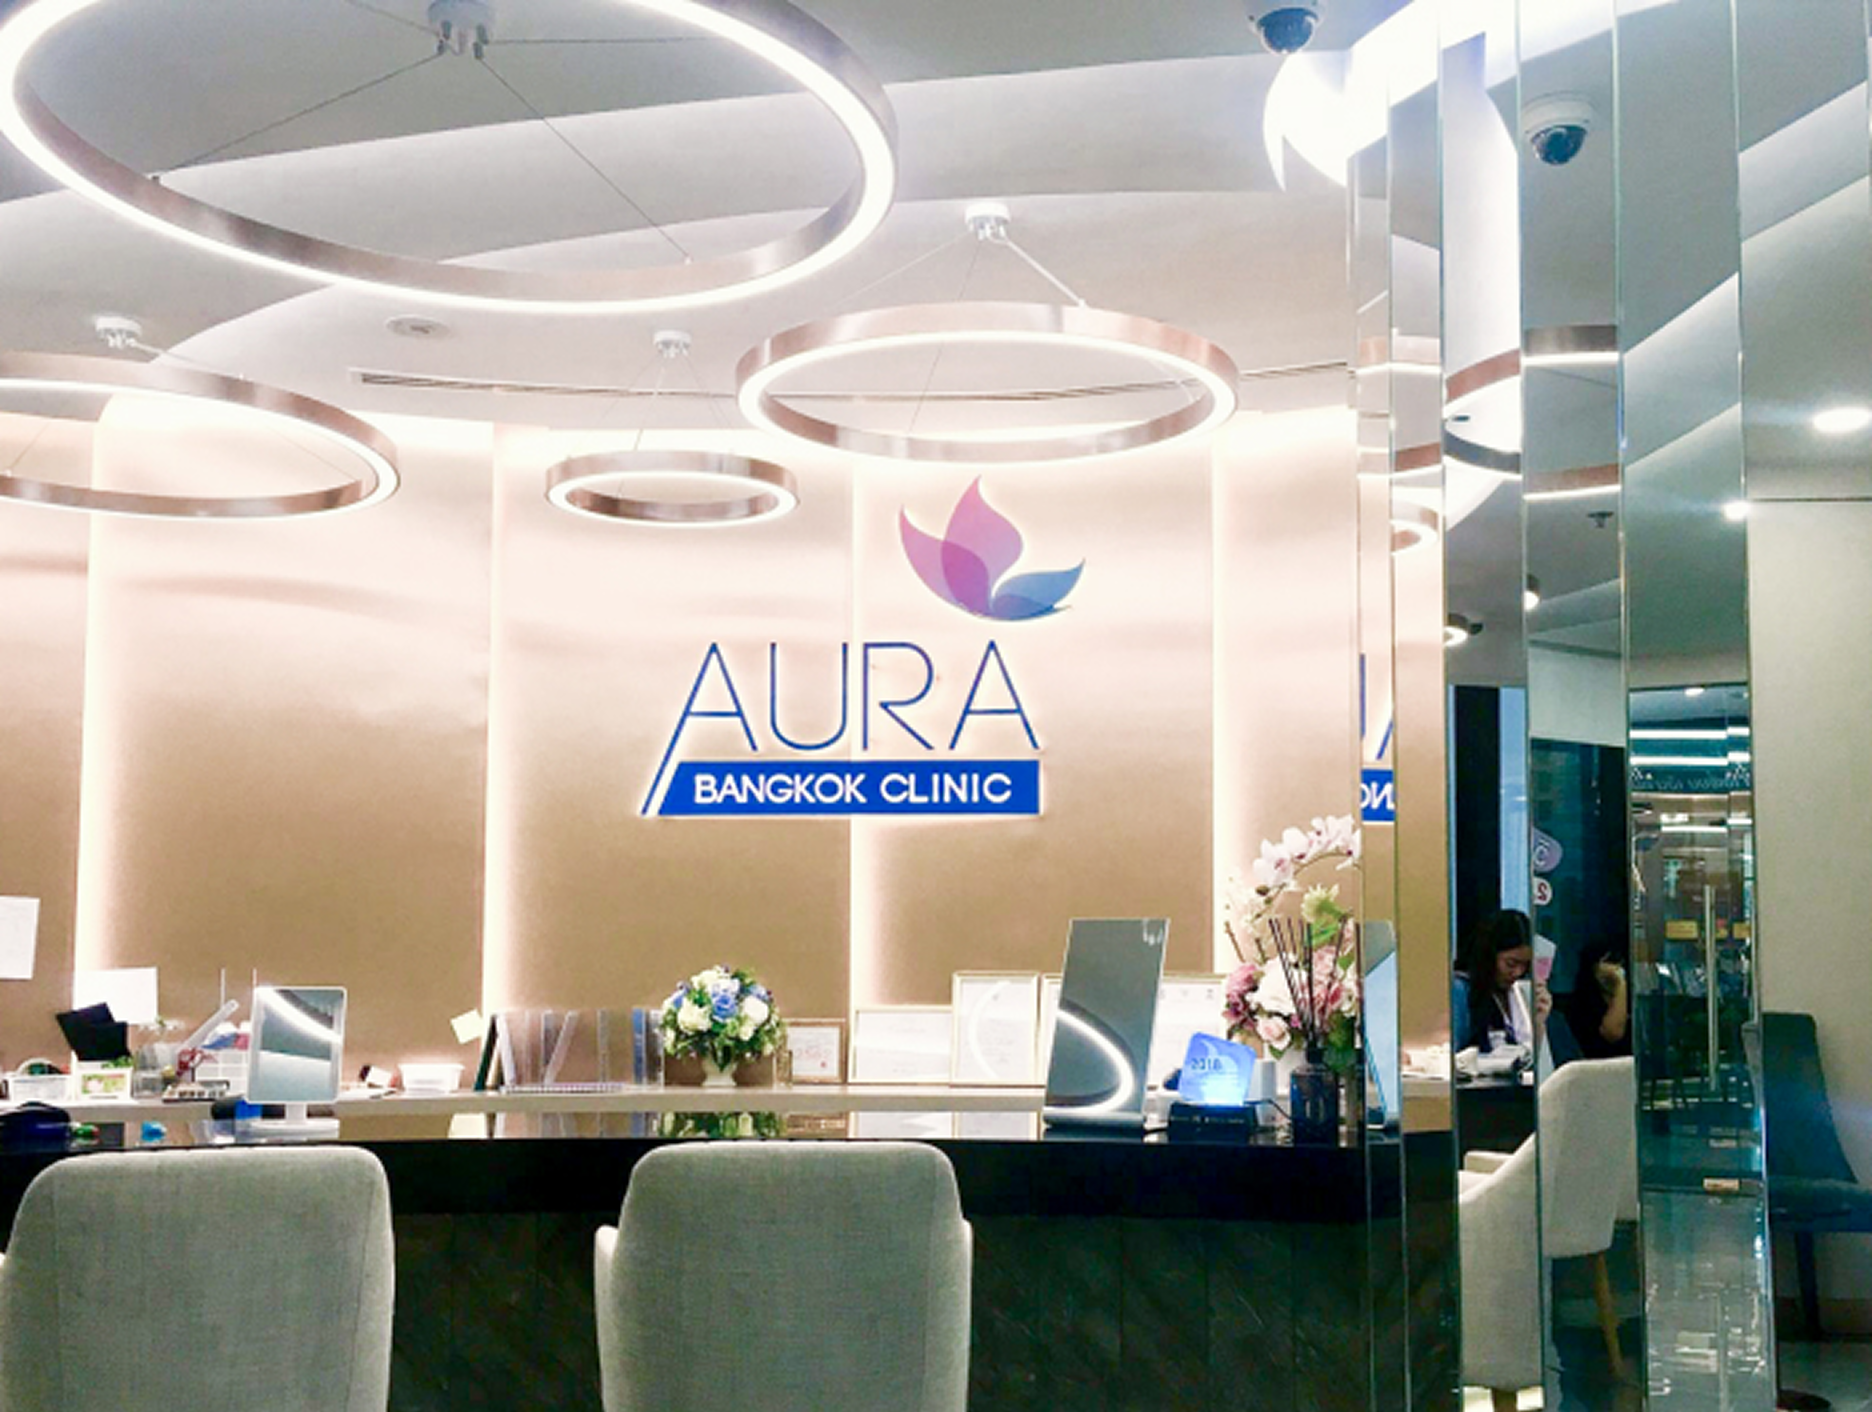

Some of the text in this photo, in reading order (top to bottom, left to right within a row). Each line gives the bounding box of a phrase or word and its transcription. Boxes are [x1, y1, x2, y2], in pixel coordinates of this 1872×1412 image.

[640, 640, 1040, 816] AURA
[693, 772, 1012, 804] BANGKOK CLINIC
